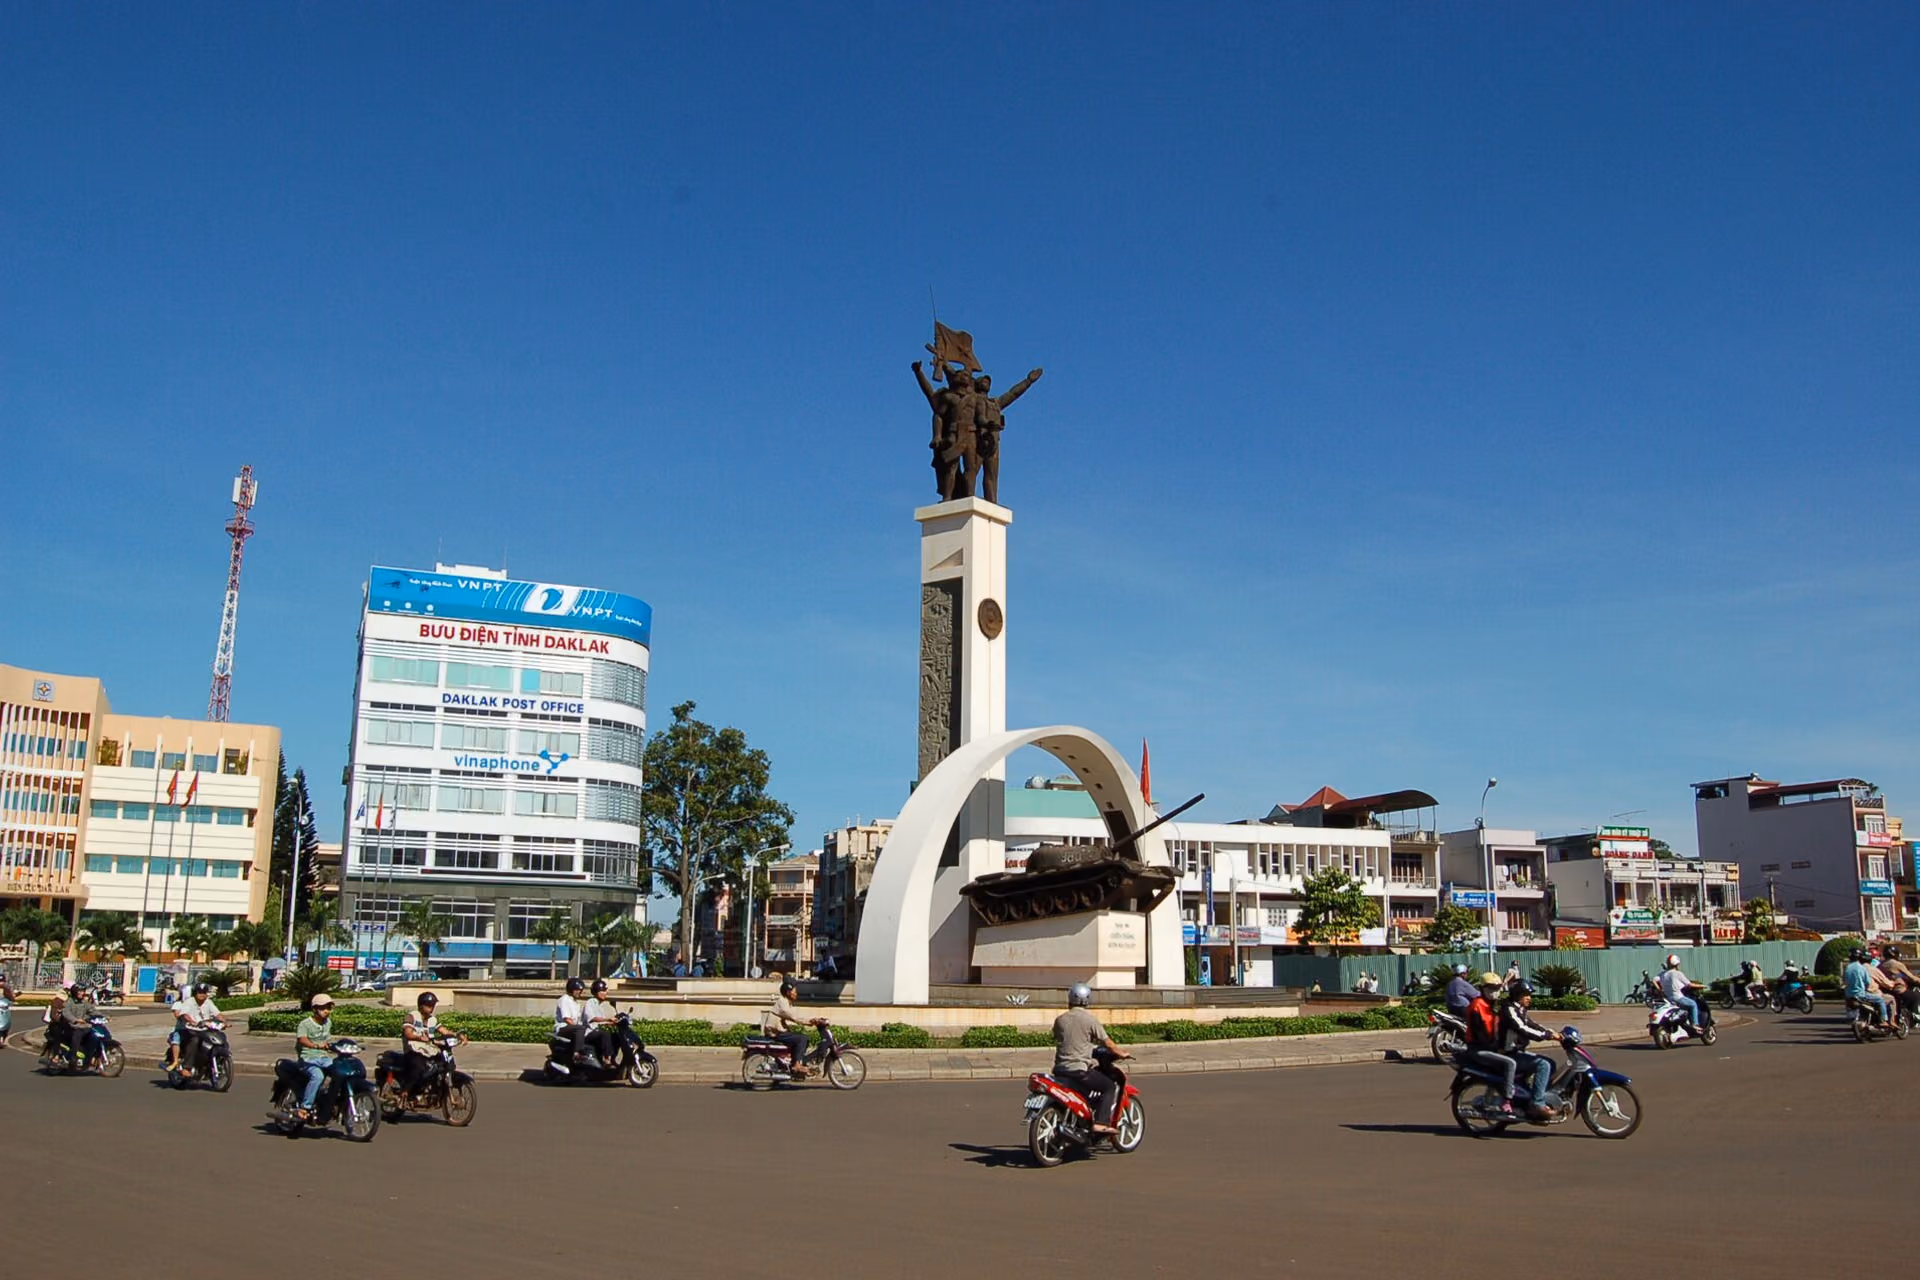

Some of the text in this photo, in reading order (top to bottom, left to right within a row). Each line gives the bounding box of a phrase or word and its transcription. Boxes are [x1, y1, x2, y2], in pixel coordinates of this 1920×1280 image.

[457, 578, 503, 592] VNPT
[571, 606, 613, 618] VNPT
[419, 624, 455, 639] BƯU
[459, 626, 499, 646] ĐIỆN
[544, 635, 609, 654] DAKLAK
[442, 693, 584, 714] DAKLAK POST OFFICE
[454, 754, 540, 772] vinaphone
